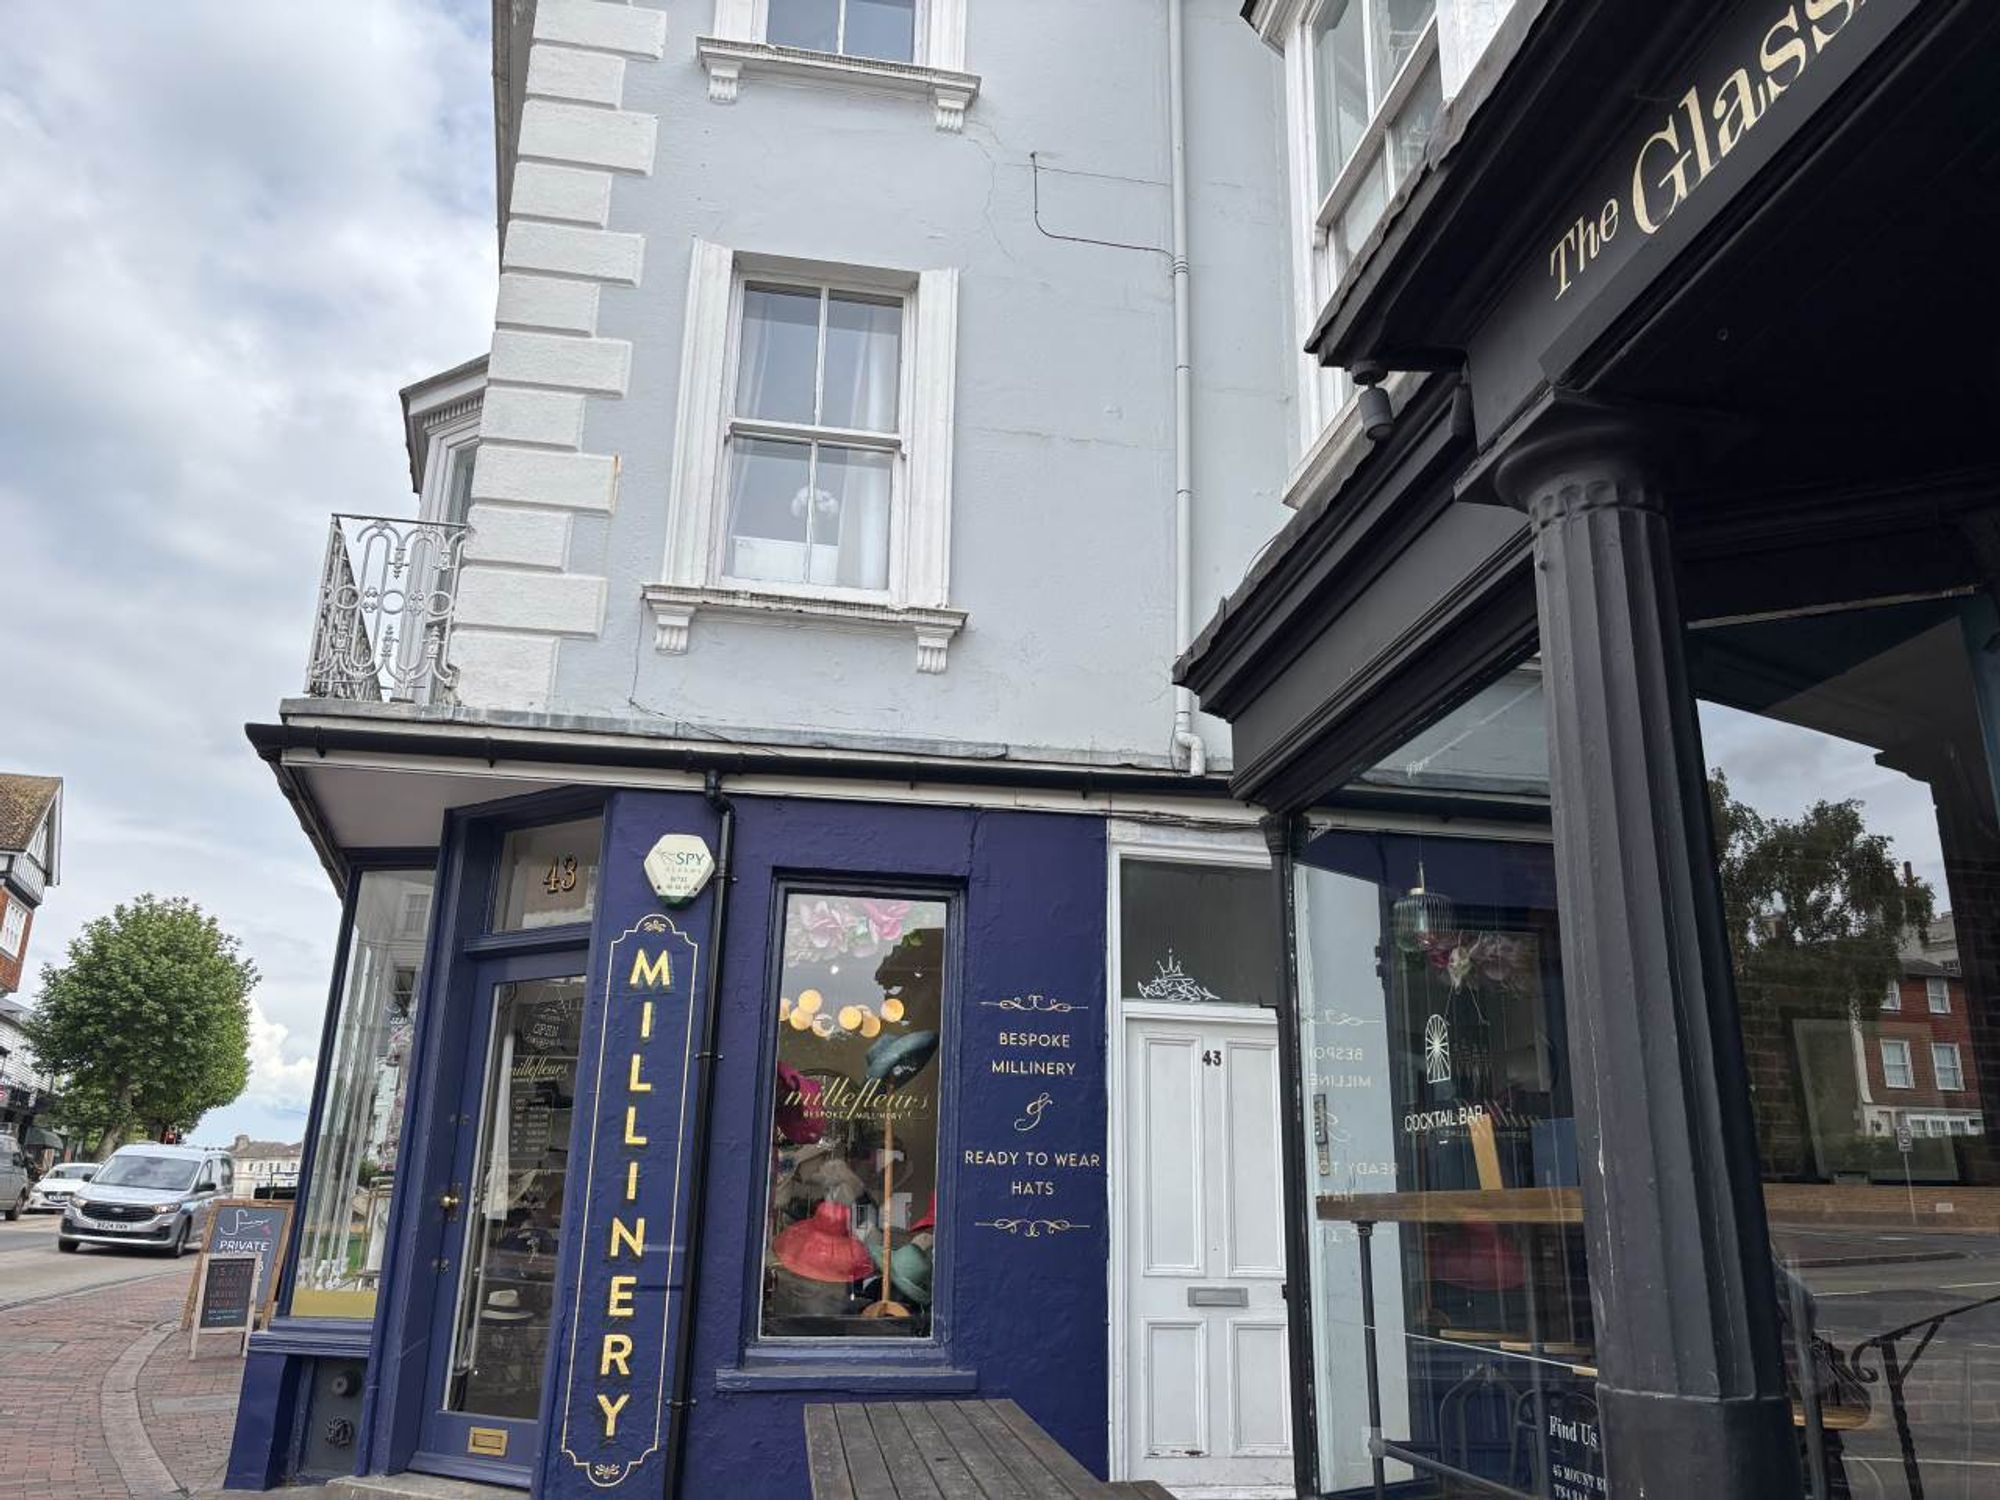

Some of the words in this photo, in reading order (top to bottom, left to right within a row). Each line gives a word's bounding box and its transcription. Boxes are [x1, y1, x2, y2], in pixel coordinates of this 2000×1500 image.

[1550, 198, 1618, 301] The
[1632, 0, 1866, 235] Glass
[543, 855, 578, 894] 43
[999, 1032, 1070, 1048] BESPOKE
[1202, 1050, 1222, 1066] 43
[991, 1060, 1077, 1076] MILLINERY
[803, 1110, 845, 1119] BESPOKE
[1404, 1108, 1457, 1132] COCKTAIL
[1459, 1104, 1483, 1126] BAR
[965, 1150, 1019, 1166] READY
[1026, 1152, 1049, 1167] TO
[1054, 1153, 1101, 1167] WEAR
[597, 949, 671, 1437] MILLINERY
[1011, 1181, 1054, 1196] HATS
[219, 1240, 270, 1252] PRIVATE
[1549, 1415, 1577, 1442] Find
[1581, 1423, 1597, 1448] Us
